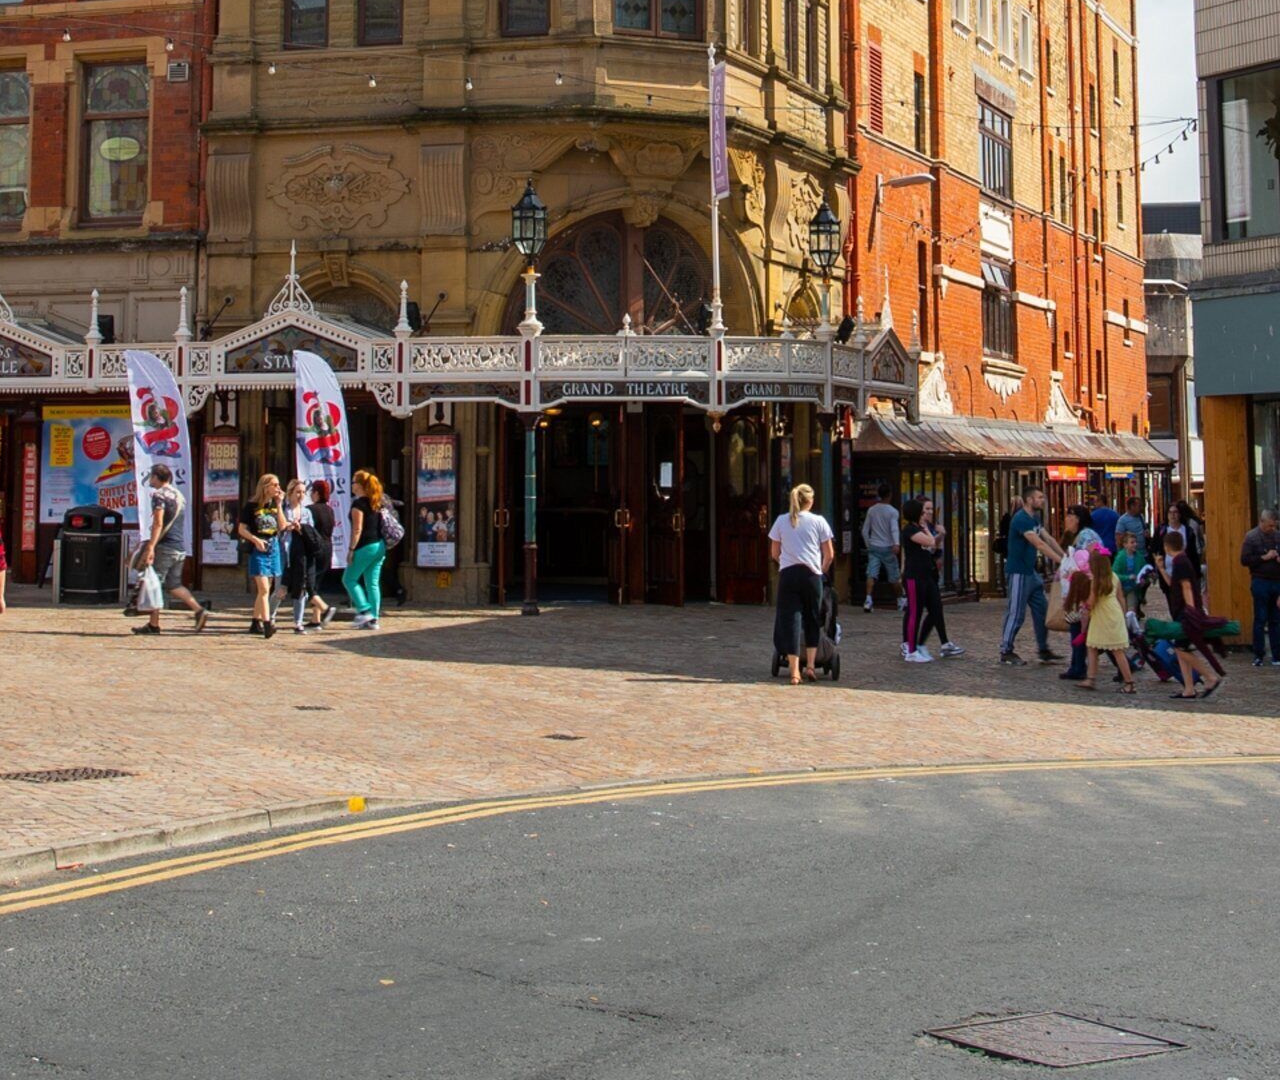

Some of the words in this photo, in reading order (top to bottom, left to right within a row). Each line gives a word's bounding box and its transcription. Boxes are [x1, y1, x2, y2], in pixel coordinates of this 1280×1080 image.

[714, 85, 722, 175] GRAND
[263, 354, 291, 369] STA
[562, 382, 615, 396] GRAND
[626, 382, 689, 396] THEATRE
[744, 383, 780, 396] GRAND
[788, 384, 818, 397] THEATRE
[208, 444, 238, 458] ABBA
[422, 444, 452, 458] ABBA
[208, 458, 238, 470] MANIA
[99, 485, 126, 497] CHITTY
[100, 496, 126, 510] BANG
